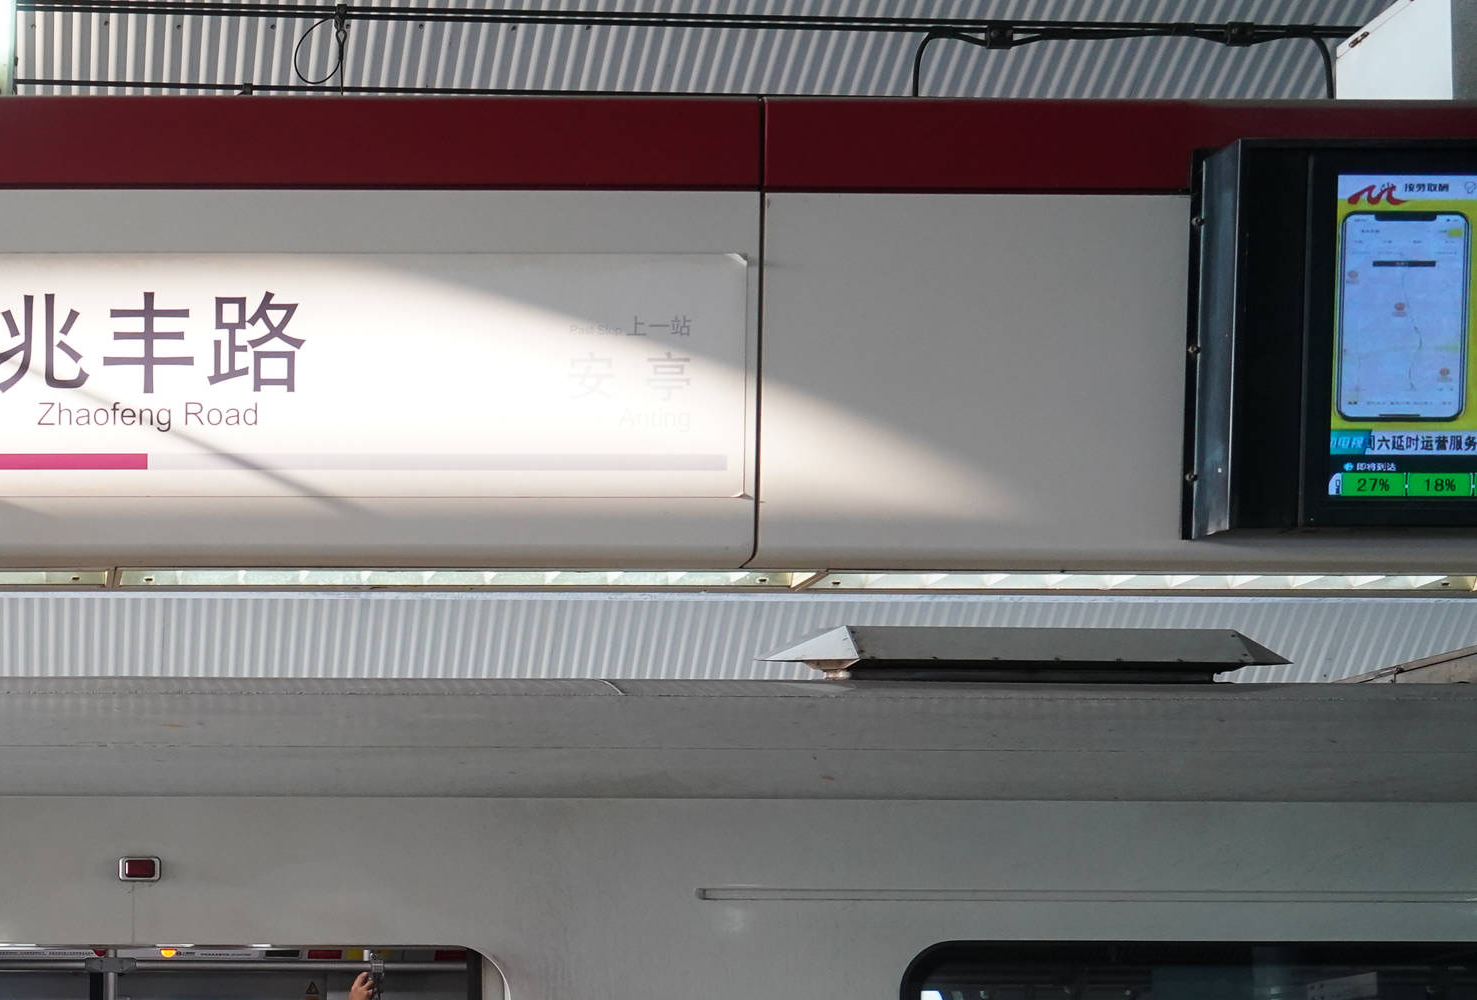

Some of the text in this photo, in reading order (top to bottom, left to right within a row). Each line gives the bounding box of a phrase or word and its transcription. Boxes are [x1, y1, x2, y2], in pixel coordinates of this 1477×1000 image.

[626, 315, 691, 336] 上一站
[568, 351, 690, 401] 安亭
[37, 402, 258, 432] Zhaofeng Road
[1356, 478, 1390, 492] 27%
[1424, 478, 1457, 492] 18%
